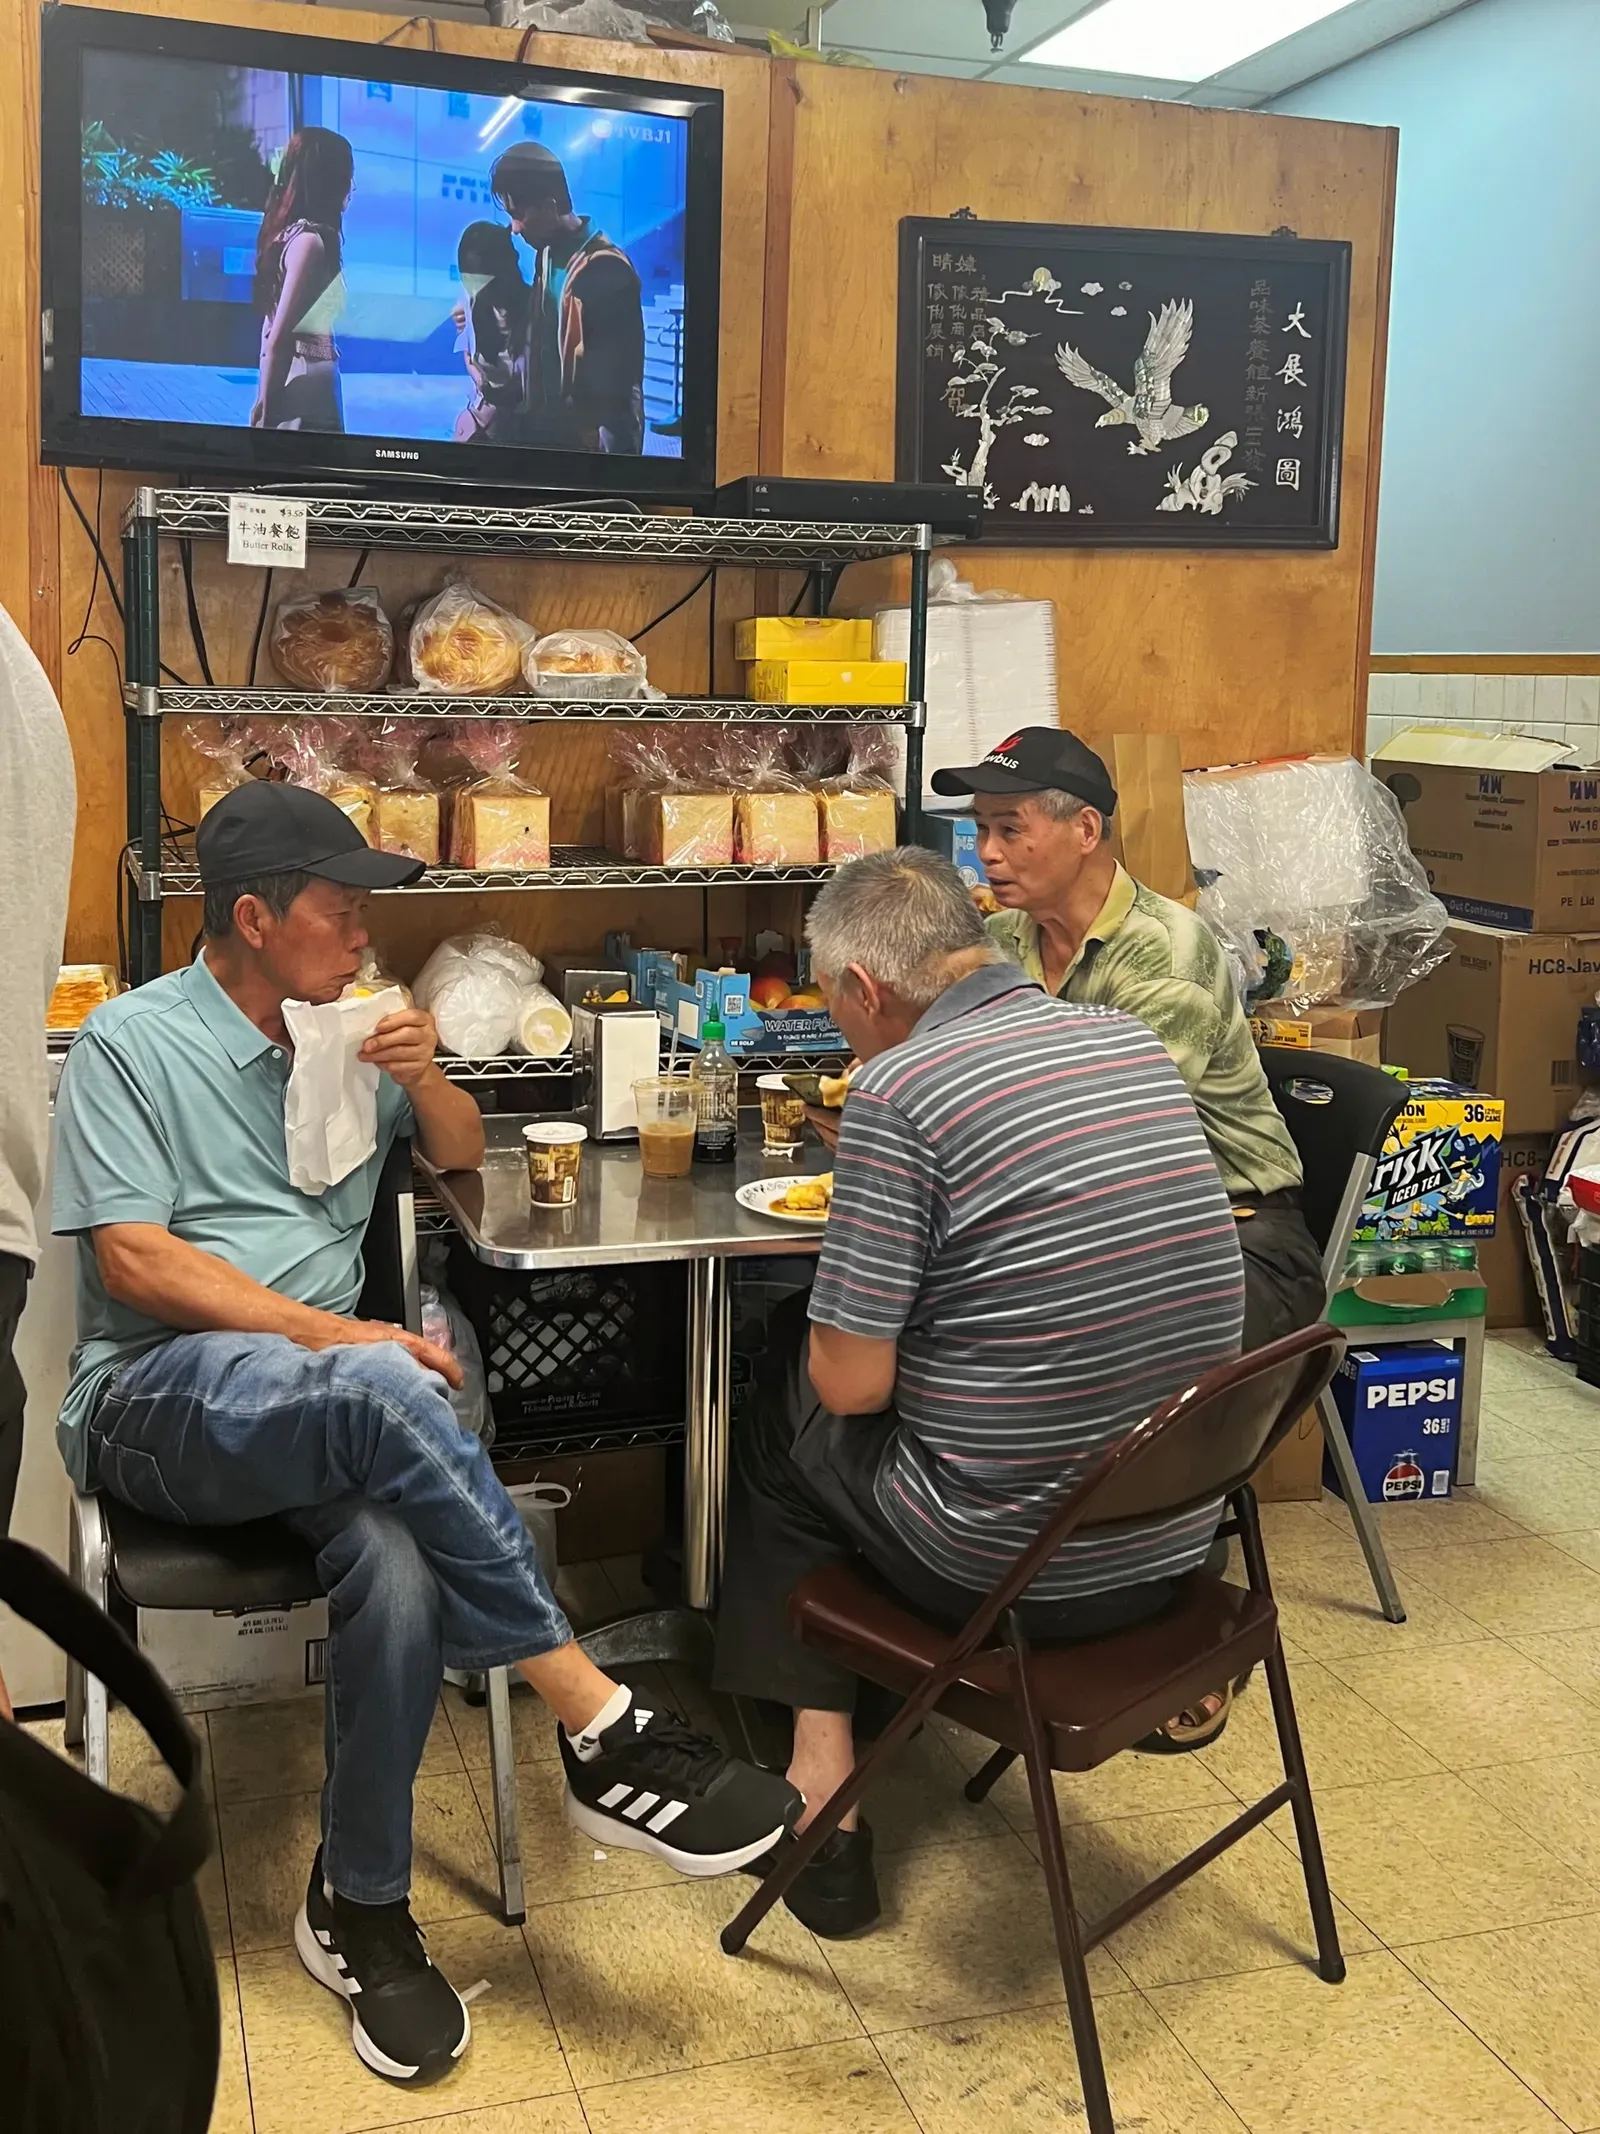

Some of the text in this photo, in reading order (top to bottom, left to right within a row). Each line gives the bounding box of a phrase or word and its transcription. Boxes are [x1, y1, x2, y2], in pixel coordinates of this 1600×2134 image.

[1275, 301, 1312, 491] 大展鴻圖
[375, 449, 419, 460] SAMSUNG
[243, 540, 293, 552] Butter Rolls
[765, 1019, 811, 1032] WATER
[1464, 1104, 1484, 1122] 36
[1392, 1172, 1441, 1205] ICED TEA
[1367, 1378, 1456, 1409] PEPSI
[1423, 1418, 1440, 1434] 36
[1386, 1480, 1422, 1491] PEPSI
